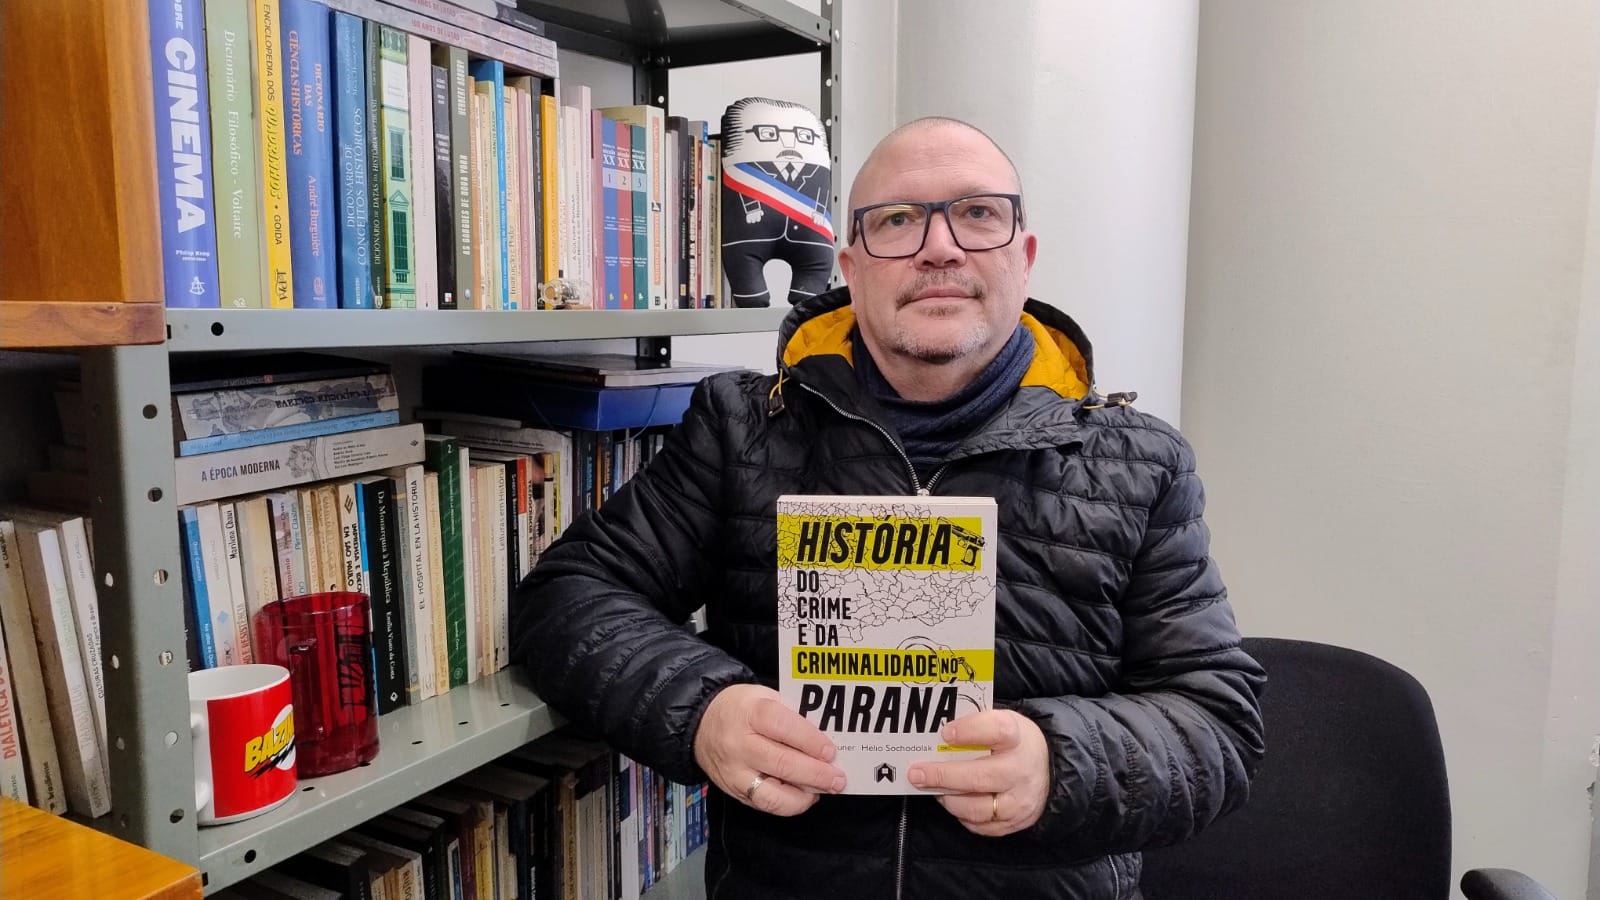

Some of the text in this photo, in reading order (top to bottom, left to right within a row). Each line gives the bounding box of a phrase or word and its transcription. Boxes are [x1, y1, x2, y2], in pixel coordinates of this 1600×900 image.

[304, 83, 314, 107] DAS
[165, 37, 206, 234] CINEMA
[223, 29, 243, 239] Dicionário Filosófico Voltaire
[263, 3, 283, 245] ENCICLOPEDIA DOS QUADRINHOS GOIDA
[344, 144, 353, 159] DE
[603, 154, 616, 166] XX
[618, 157, 630, 169] XX
[459, 154, 469, 174] YORK
[632, 160, 646, 170] XX
[607, 174, 612, 183] 1
[622, 176, 627, 185] 2
[637, 178, 642, 187] 3
[372, 184, 380, 209] DATAS
[355, 189, 367, 266] CONCEITOS
[462, 245, 471, 256] AS
[447, 444, 452, 454] 2
[201, 460, 281, 483] A ÉPOCA MODERNA
[377, 490, 385, 504] Da
[343, 525, 350, 538] EM
[379, 505, 388, 552] Monarquia
[797, 514, 953, 566] HISTÓRIA
[351, 523, 360, 562] IMPRENSA
[411, 479, 425, 610] EL HOSPITAL EN LA HISTORIA
[346, 560, 354, 587] PAULO
[381, 560, 392, 604] República
[796, 570, 820, 593] DO
[797, 597, 852, 620] CRIME
[798, 624, 839, 646] E DA
[86, 632, 104, 699] CULTURAS CRUZADAS
[797, 651, 959, 677] CRIMINALIDADE NO
[799, 677, 959, 734] PARANÁ
[886, 744, 932, 752] Sochodolak
